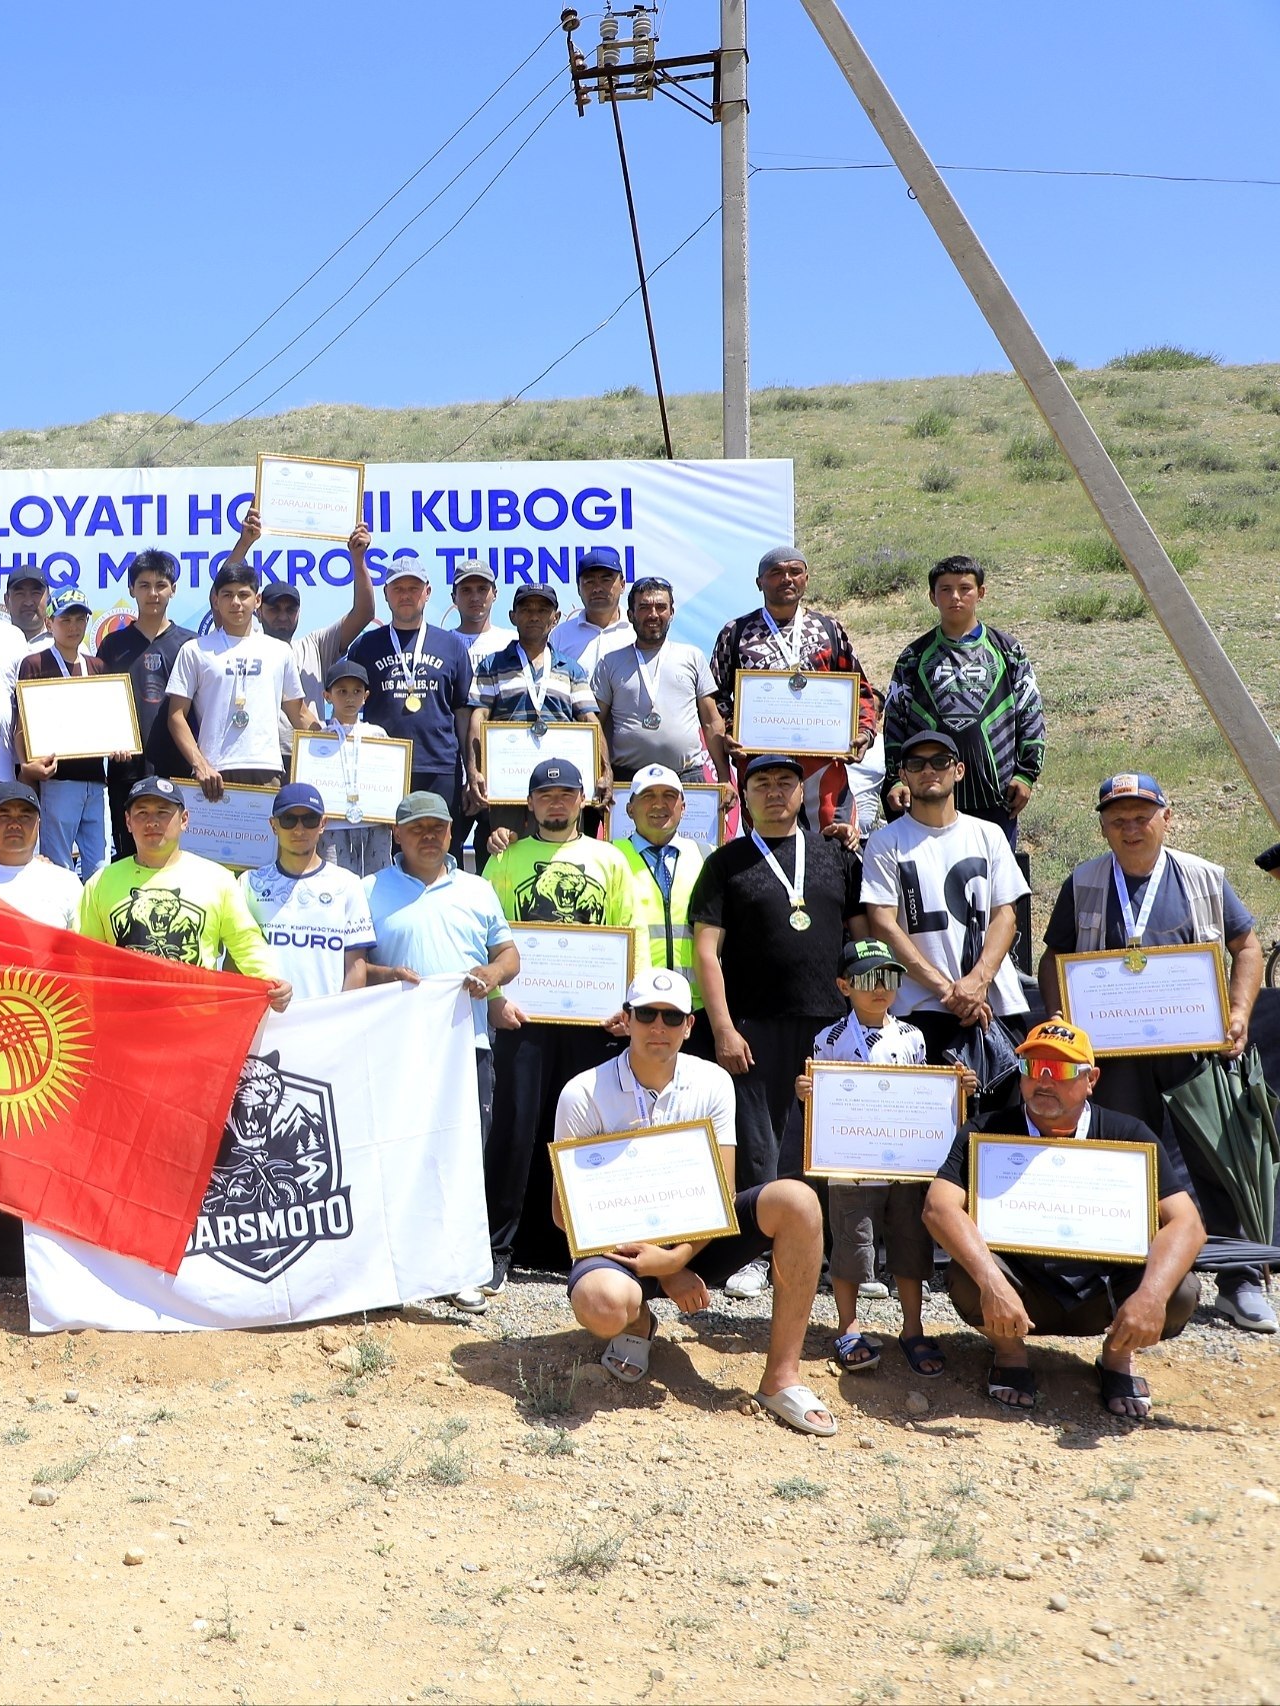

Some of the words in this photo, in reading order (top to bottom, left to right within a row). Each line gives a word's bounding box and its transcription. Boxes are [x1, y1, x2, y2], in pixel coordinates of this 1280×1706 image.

[189, 491, 391, 535] HOI
[412, 487, 633, 532] KUBOGI
[271, 498, 316, 509] 2-DARAJALI
[317, 502, 348, 512] DIPLOM
[381, 680, 394, 691] LOS
[429, 680, 438, 691] CA
[752, 716, 804, 726] 3-DARAJALI
[806, 717, 841, 727] DIPLOM
[360, 783, 393, 793] DIPLOM
[185, 827, 233, 839] 3-DARAJALI
[235, 832, 269, 842] DIPLOM
[907, 888, 918, 926] LACOSTE
[858, 950, 892, 959] Kawasaki
[517, 977, 573, 988] 1-DARAJALI
[576, 980, 615, 990] DIPLOM
[1159, 1004, 1206, 1015] DIPLOM
[1037, 1025, 1076, 1040] KTM
[830, 1125, 896, 1138] 1-DARAJALI
[899, 1128, 944, 1140] DIPLOM
[588, 1195, 656, 1212] 1-DARAJALI
[659, 1185, 706, 1201] DIPLOM
[998, 1199, 1074, 1214] 1-DARAJALI
[1078, 1206, 1131, 1219] DIPLOM
